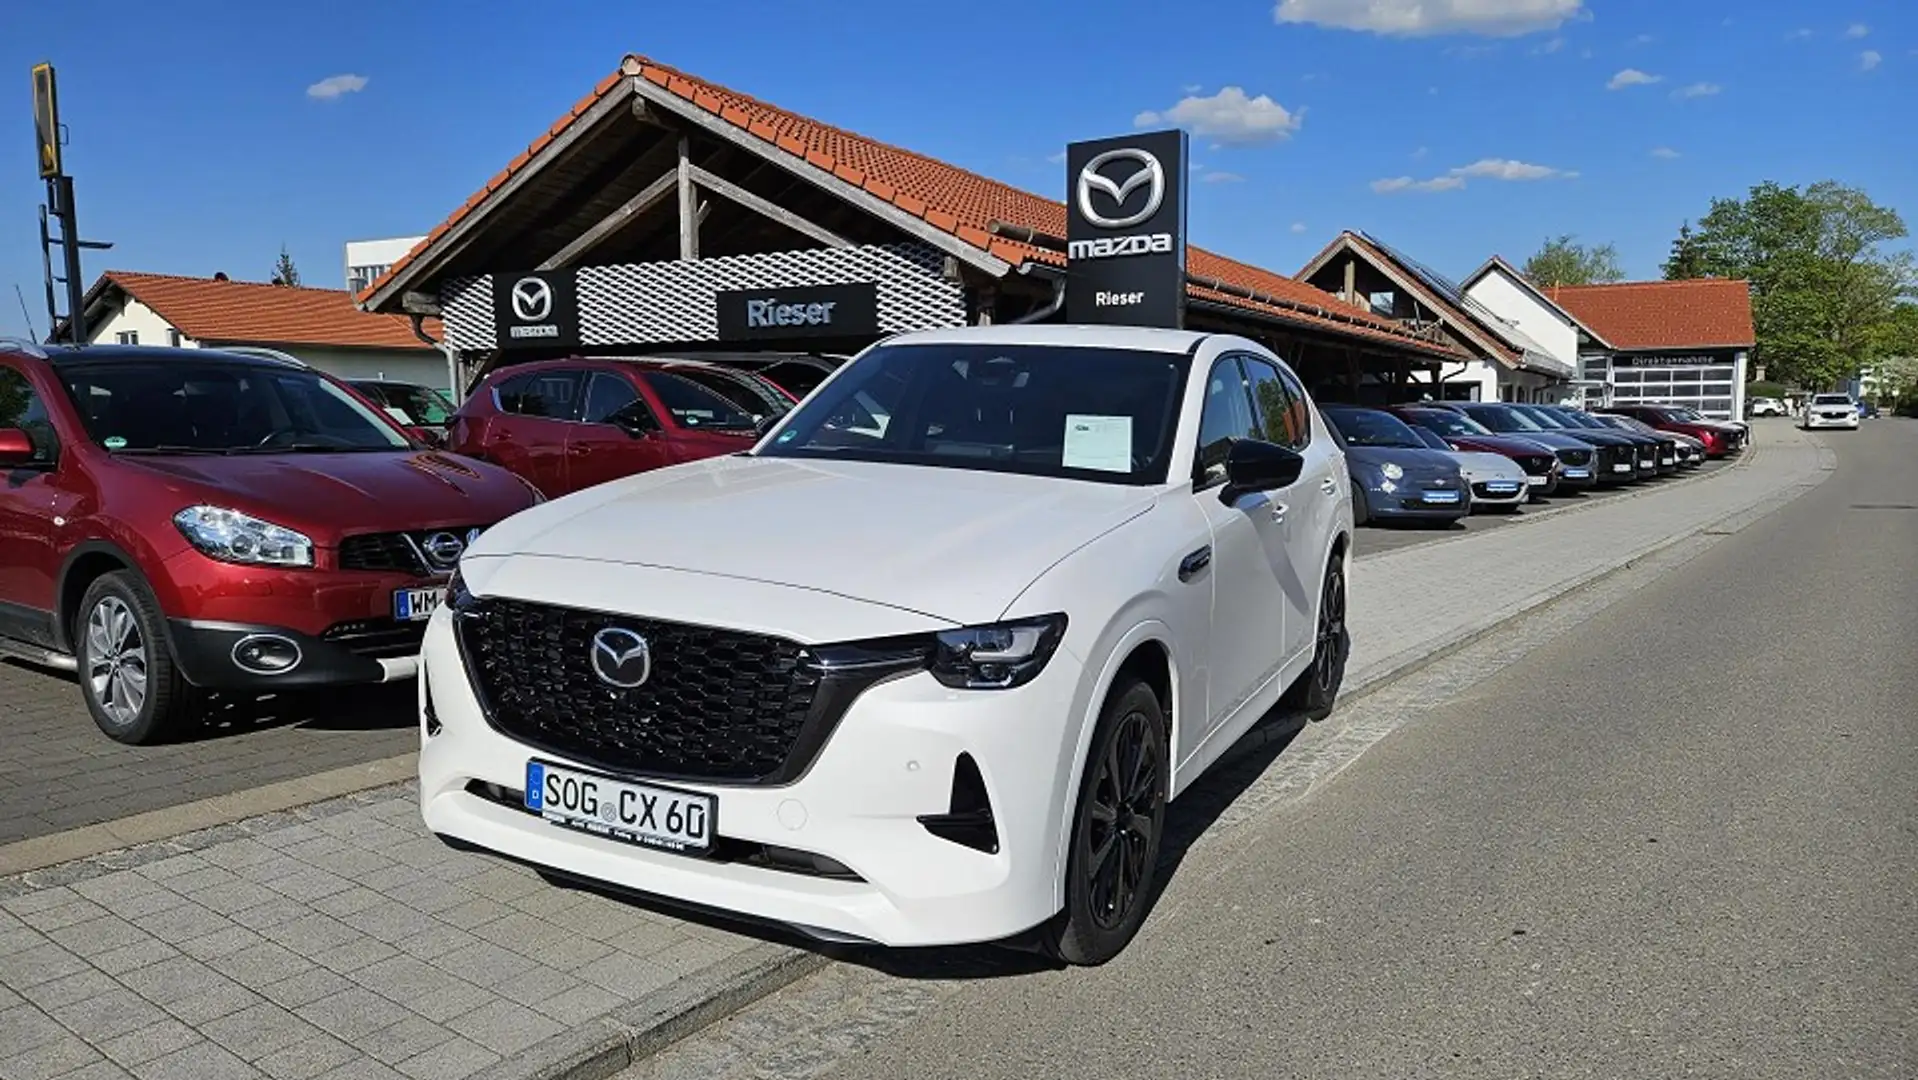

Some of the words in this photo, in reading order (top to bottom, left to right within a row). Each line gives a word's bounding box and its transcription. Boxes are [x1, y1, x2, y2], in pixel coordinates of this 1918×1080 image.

[747, 298, 837, 327] Rieser
[1096, 291, 1145, 307] Rieser
[545, 774, 598, 817] SOG
[619, 790, 657, 831] CX
[666, 800, 706, 839] 60
